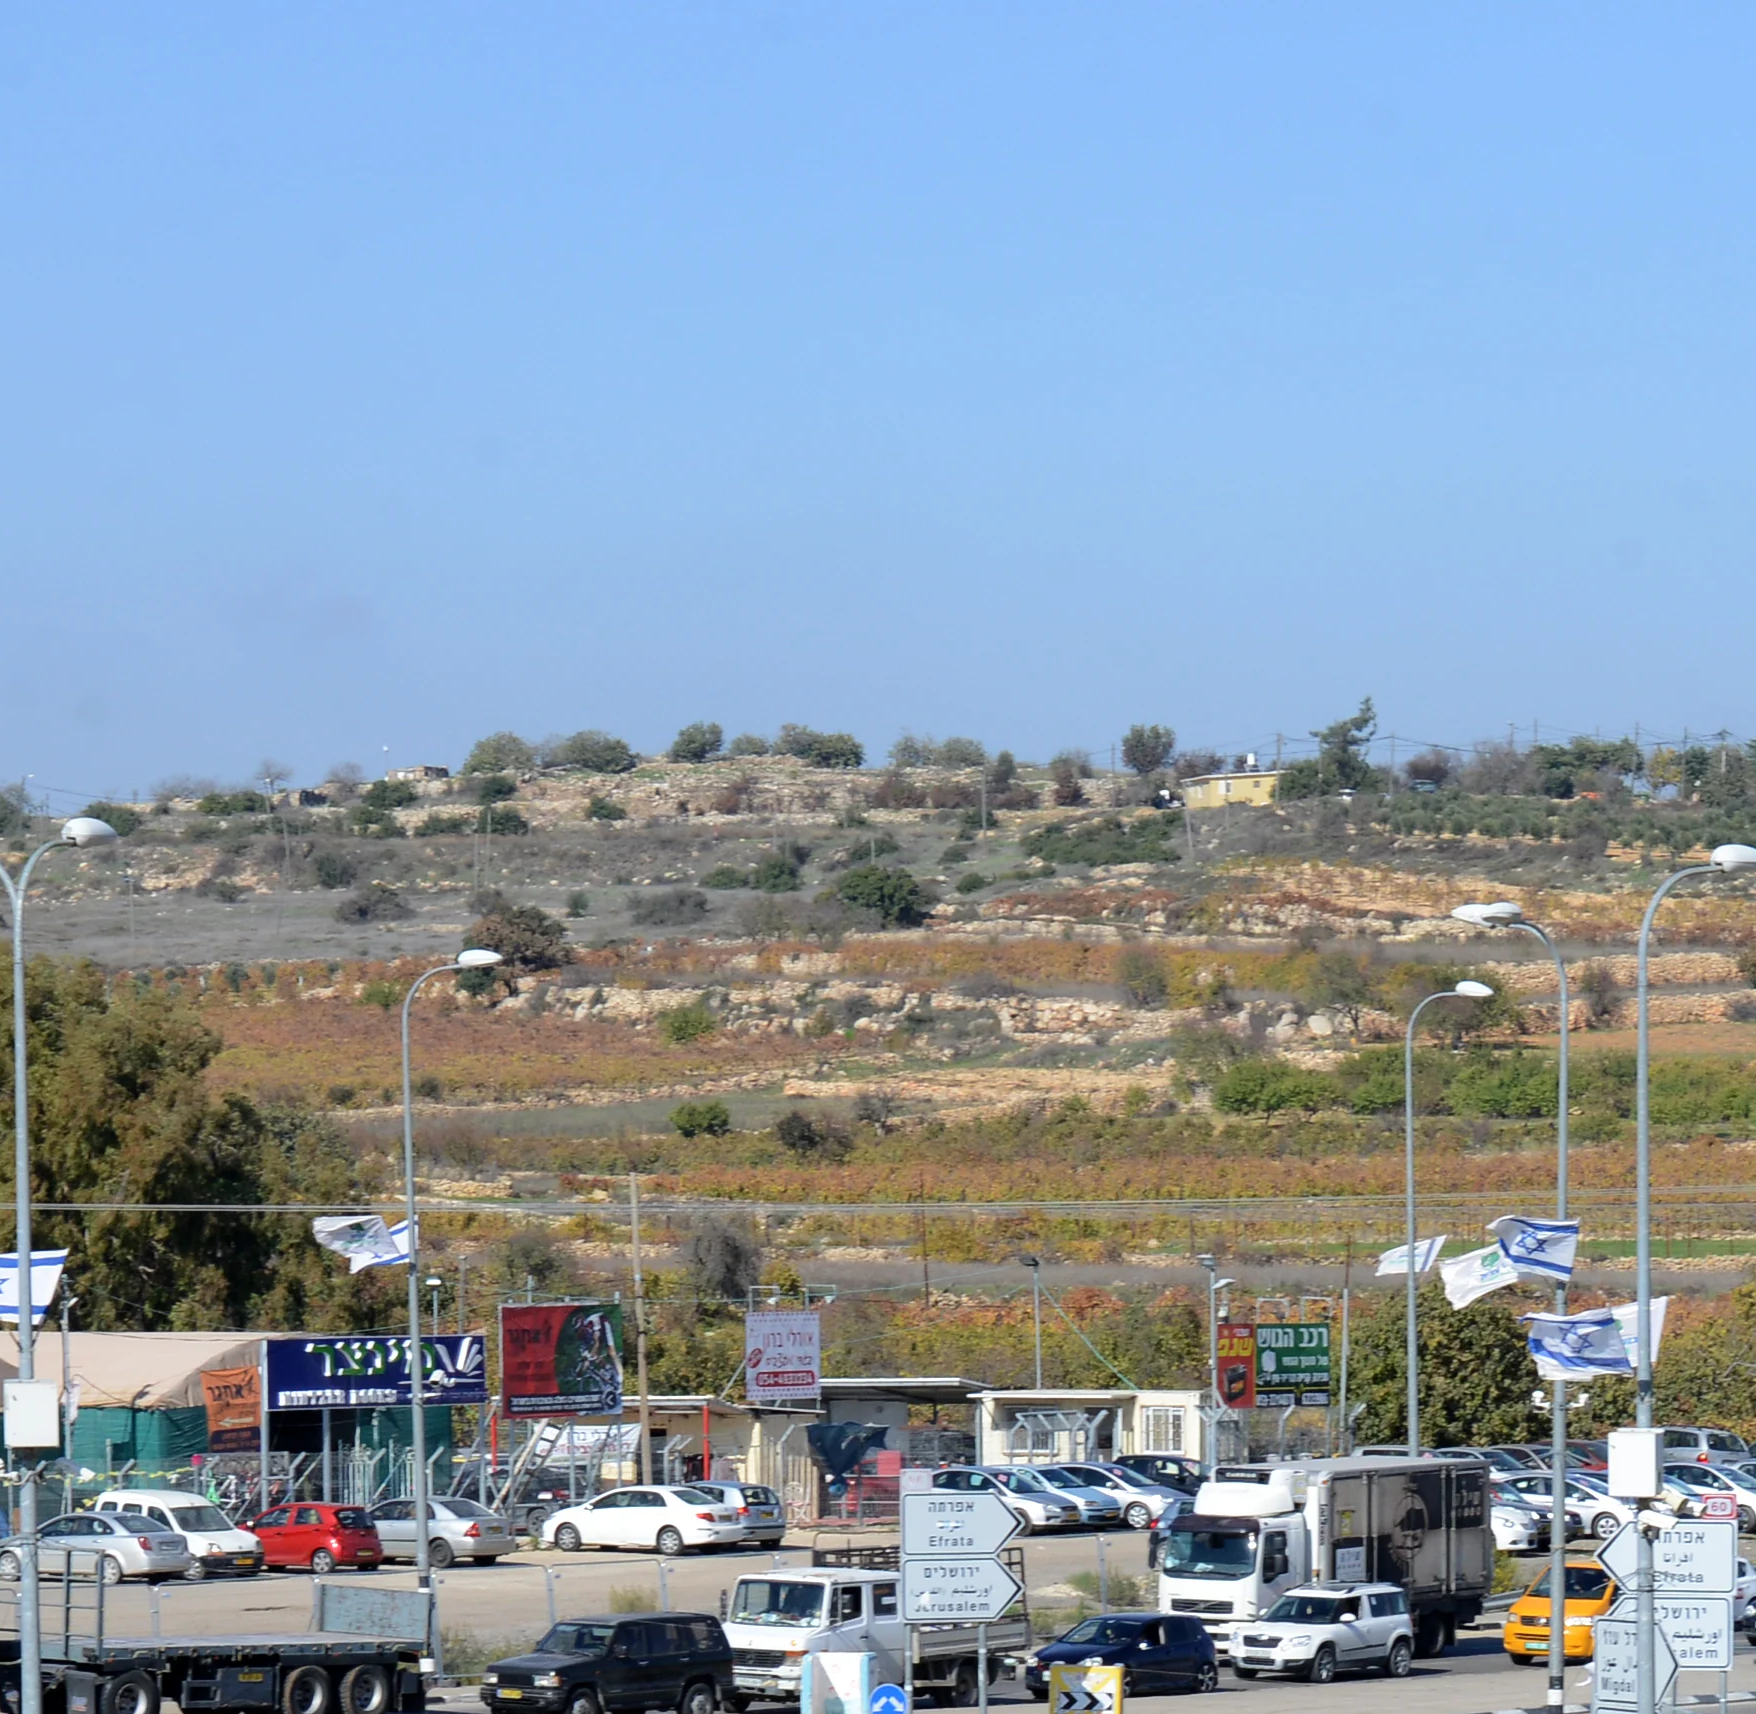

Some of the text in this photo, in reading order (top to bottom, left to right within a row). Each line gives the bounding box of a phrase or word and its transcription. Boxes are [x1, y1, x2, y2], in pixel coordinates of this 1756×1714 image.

[1256, 1327, 1329, 1348] רכב הגוש
[305, 1339, 437, 1377] מינצר
[927, 1501, 975, 1513] אפרתה
[1710, 1501, 1728, 1512] 60
[928, 1536, 974, 1547] Efrata
[1656, 1531, 1706, 1544] אפרת
[923, 1567, 981, 1578] ירושלים
[1653, 1605, 1707, 1620] ירושלי
[1600, 1676, 1635, 1695] Migdal
